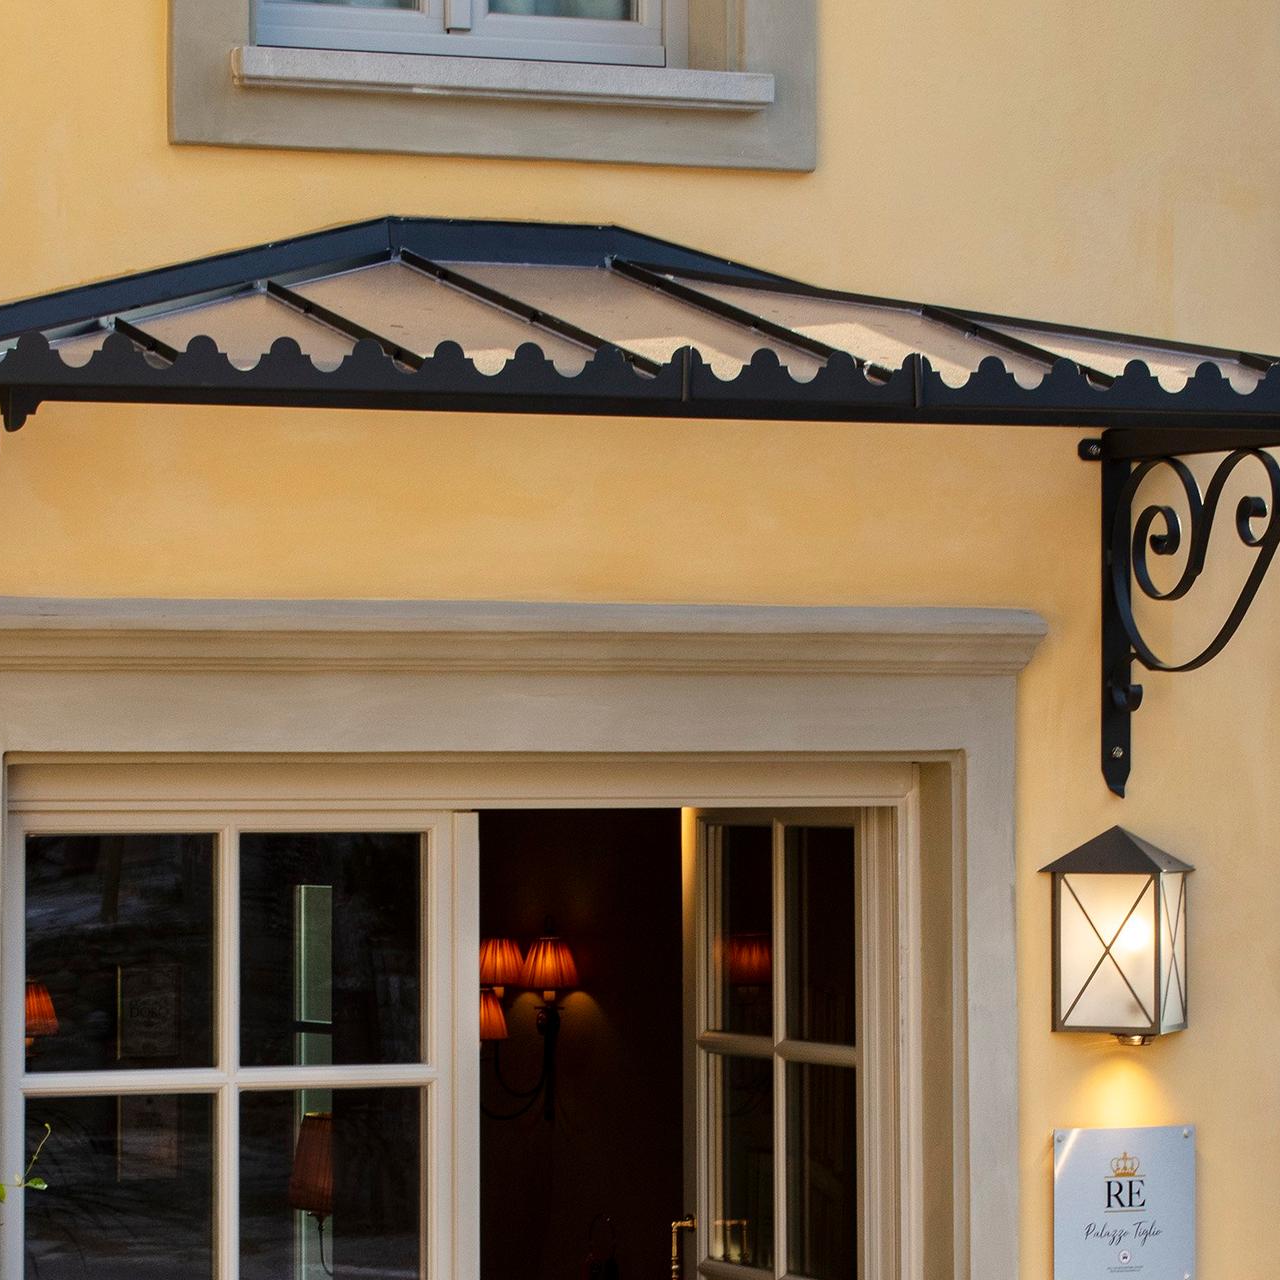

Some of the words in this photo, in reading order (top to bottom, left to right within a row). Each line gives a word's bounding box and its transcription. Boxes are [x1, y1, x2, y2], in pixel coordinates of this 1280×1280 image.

[1104, 1179, 1146, 1209] RE
[1084, 1222, 1129, 1246] Palazzo
[1132, 1219, 1163, 1247] Tiglio
